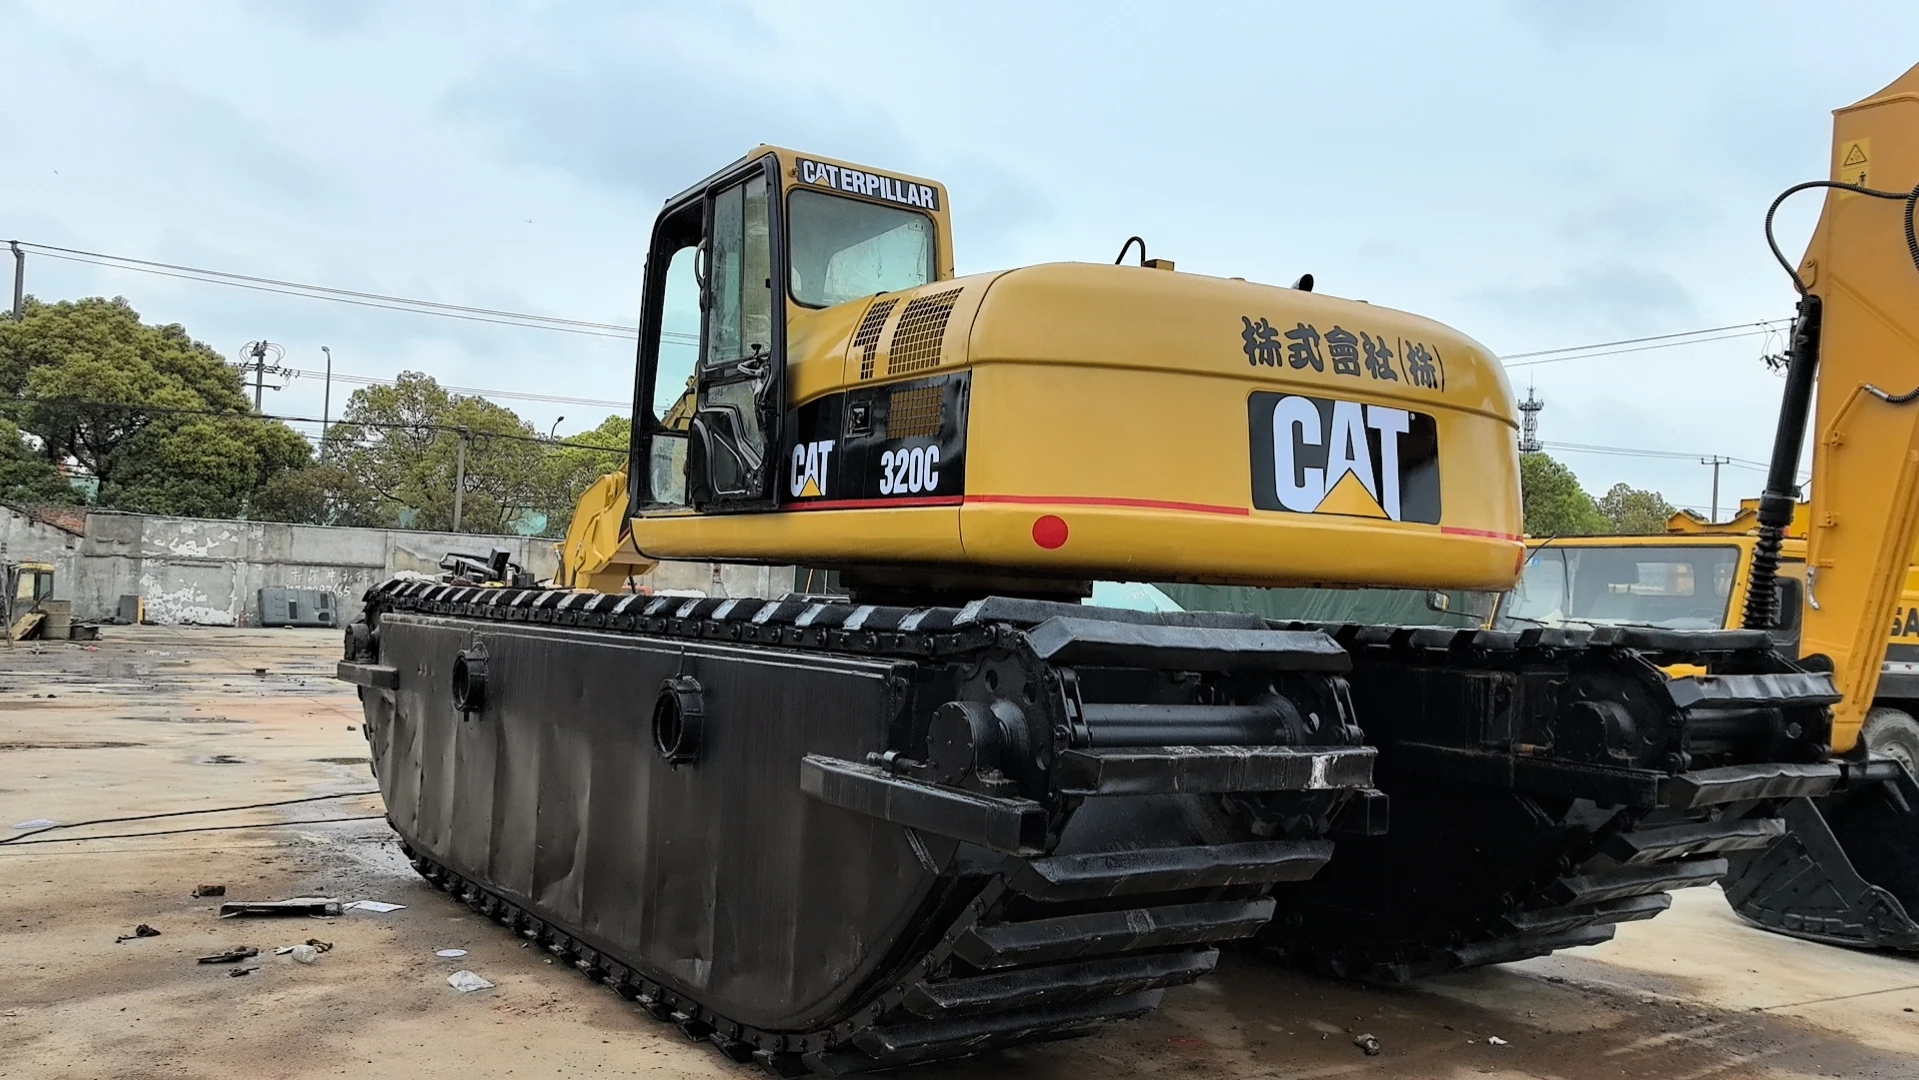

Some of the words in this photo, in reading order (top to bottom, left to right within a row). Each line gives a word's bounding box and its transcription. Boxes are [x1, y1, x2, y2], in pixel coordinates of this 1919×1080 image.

[802, 159, 935, 210] CATERPILLAR
[790, 439, 836, 498] CAT
[879, 444, 941, 496] 320C
[1272, 395, 1410, 521] CAT
